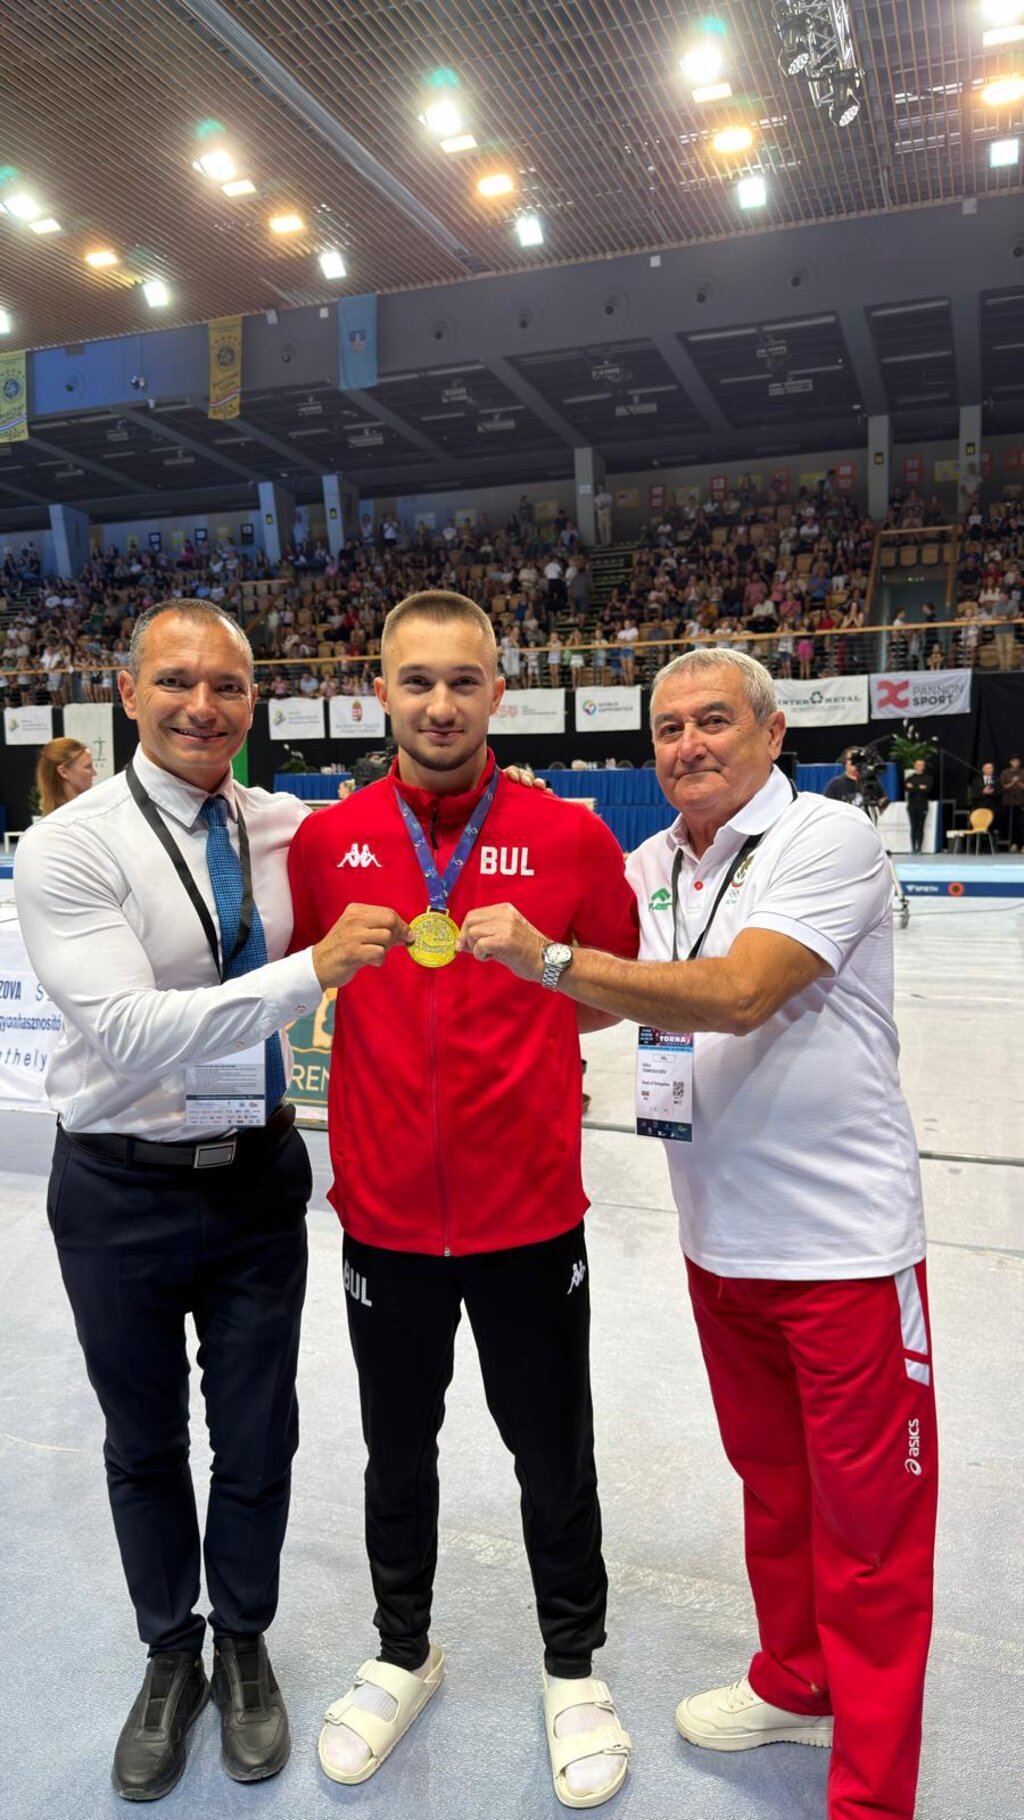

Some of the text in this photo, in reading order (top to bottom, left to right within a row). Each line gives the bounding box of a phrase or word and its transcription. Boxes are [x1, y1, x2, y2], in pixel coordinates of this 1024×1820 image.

[913, 685, 964, 696] PANNON
[913, 694, 953, 706] SPORT
[480, 846, 534, 876] BUL
[344, 1259, 373, 1308] BUL
[908, 1418, 920, 1457] asics
